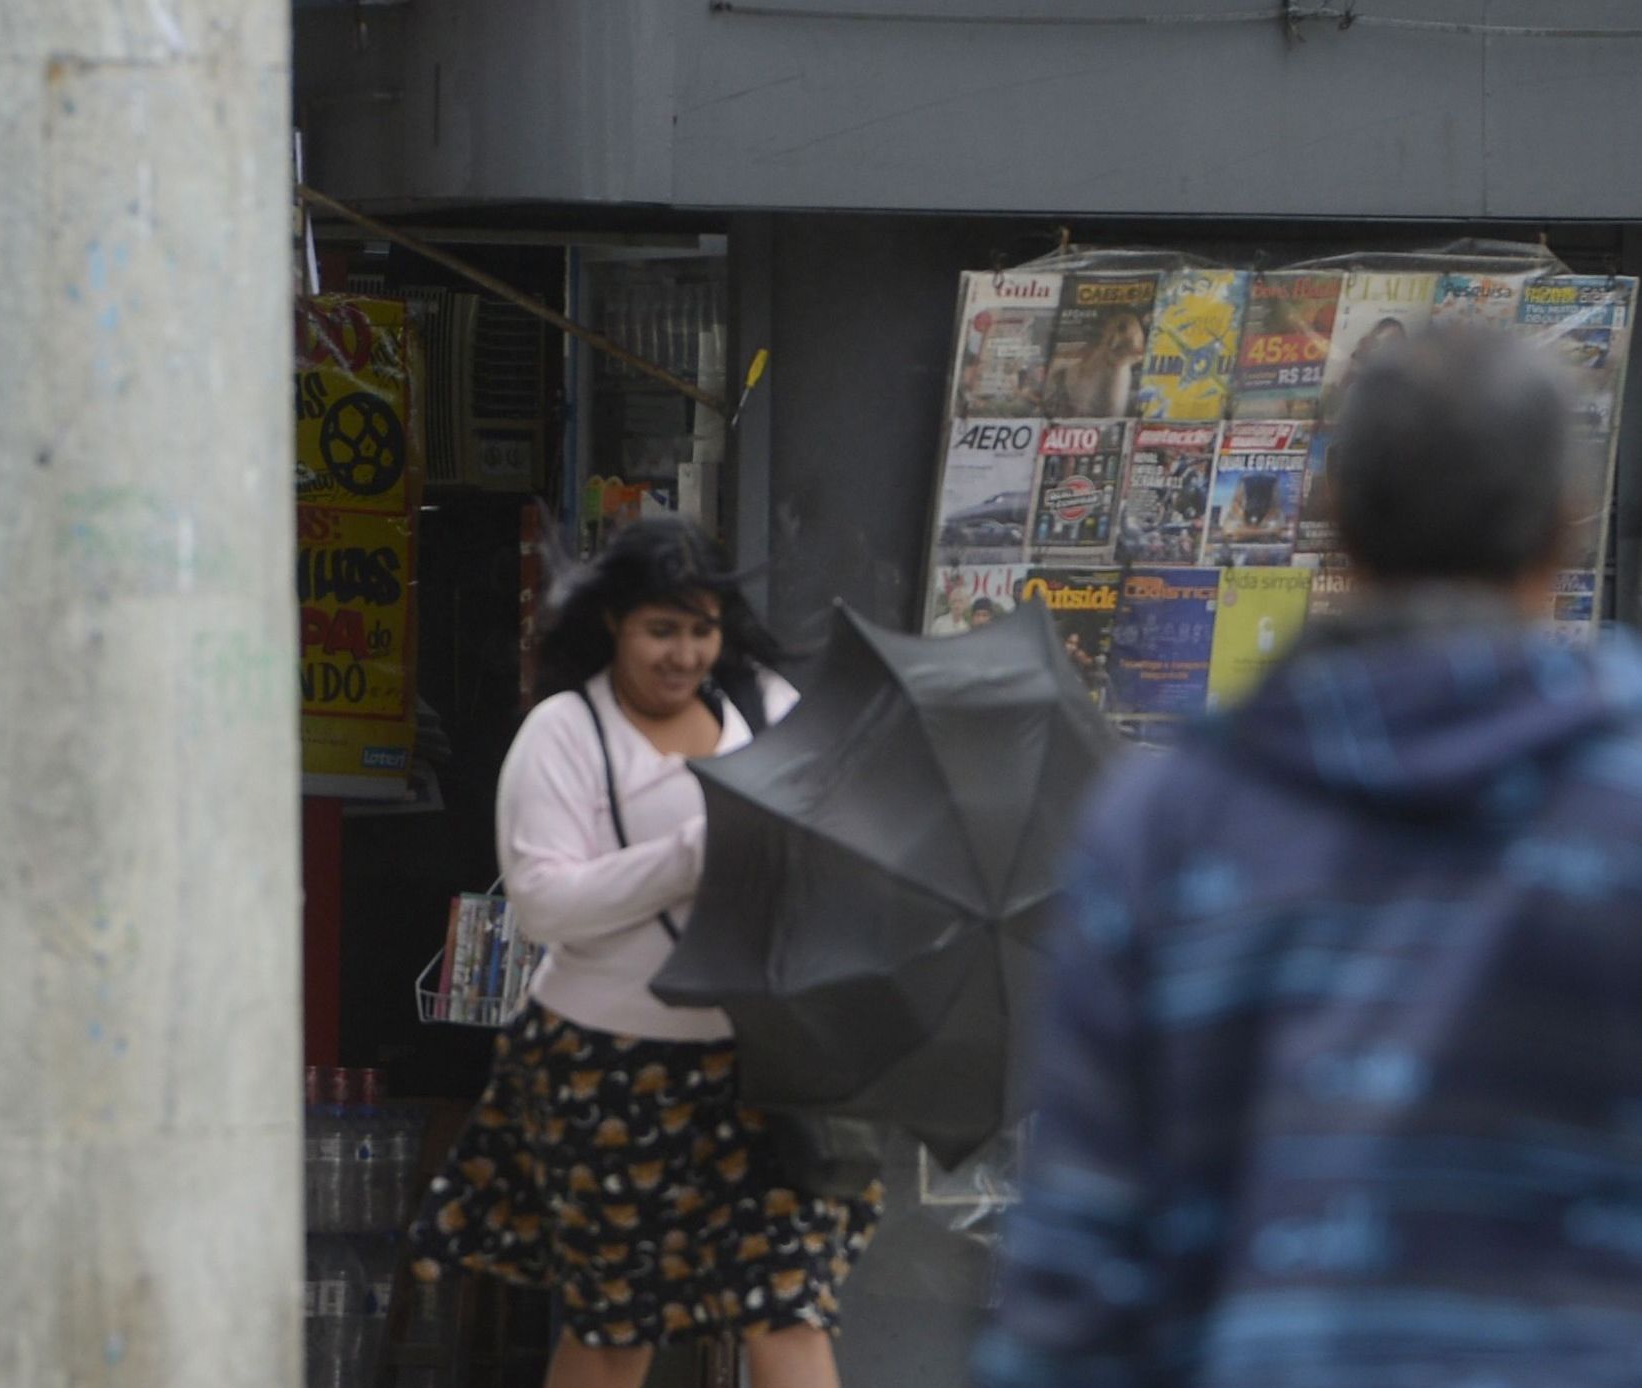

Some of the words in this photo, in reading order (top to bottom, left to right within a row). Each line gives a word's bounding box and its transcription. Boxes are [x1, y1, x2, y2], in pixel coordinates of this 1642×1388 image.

[997, 279, 1051, 298] Gula
[1247, 336, 1298, 364] 45%
[956, 425, 1032, 450] AERO
[1044, 429, 1098, 449] AUTO
